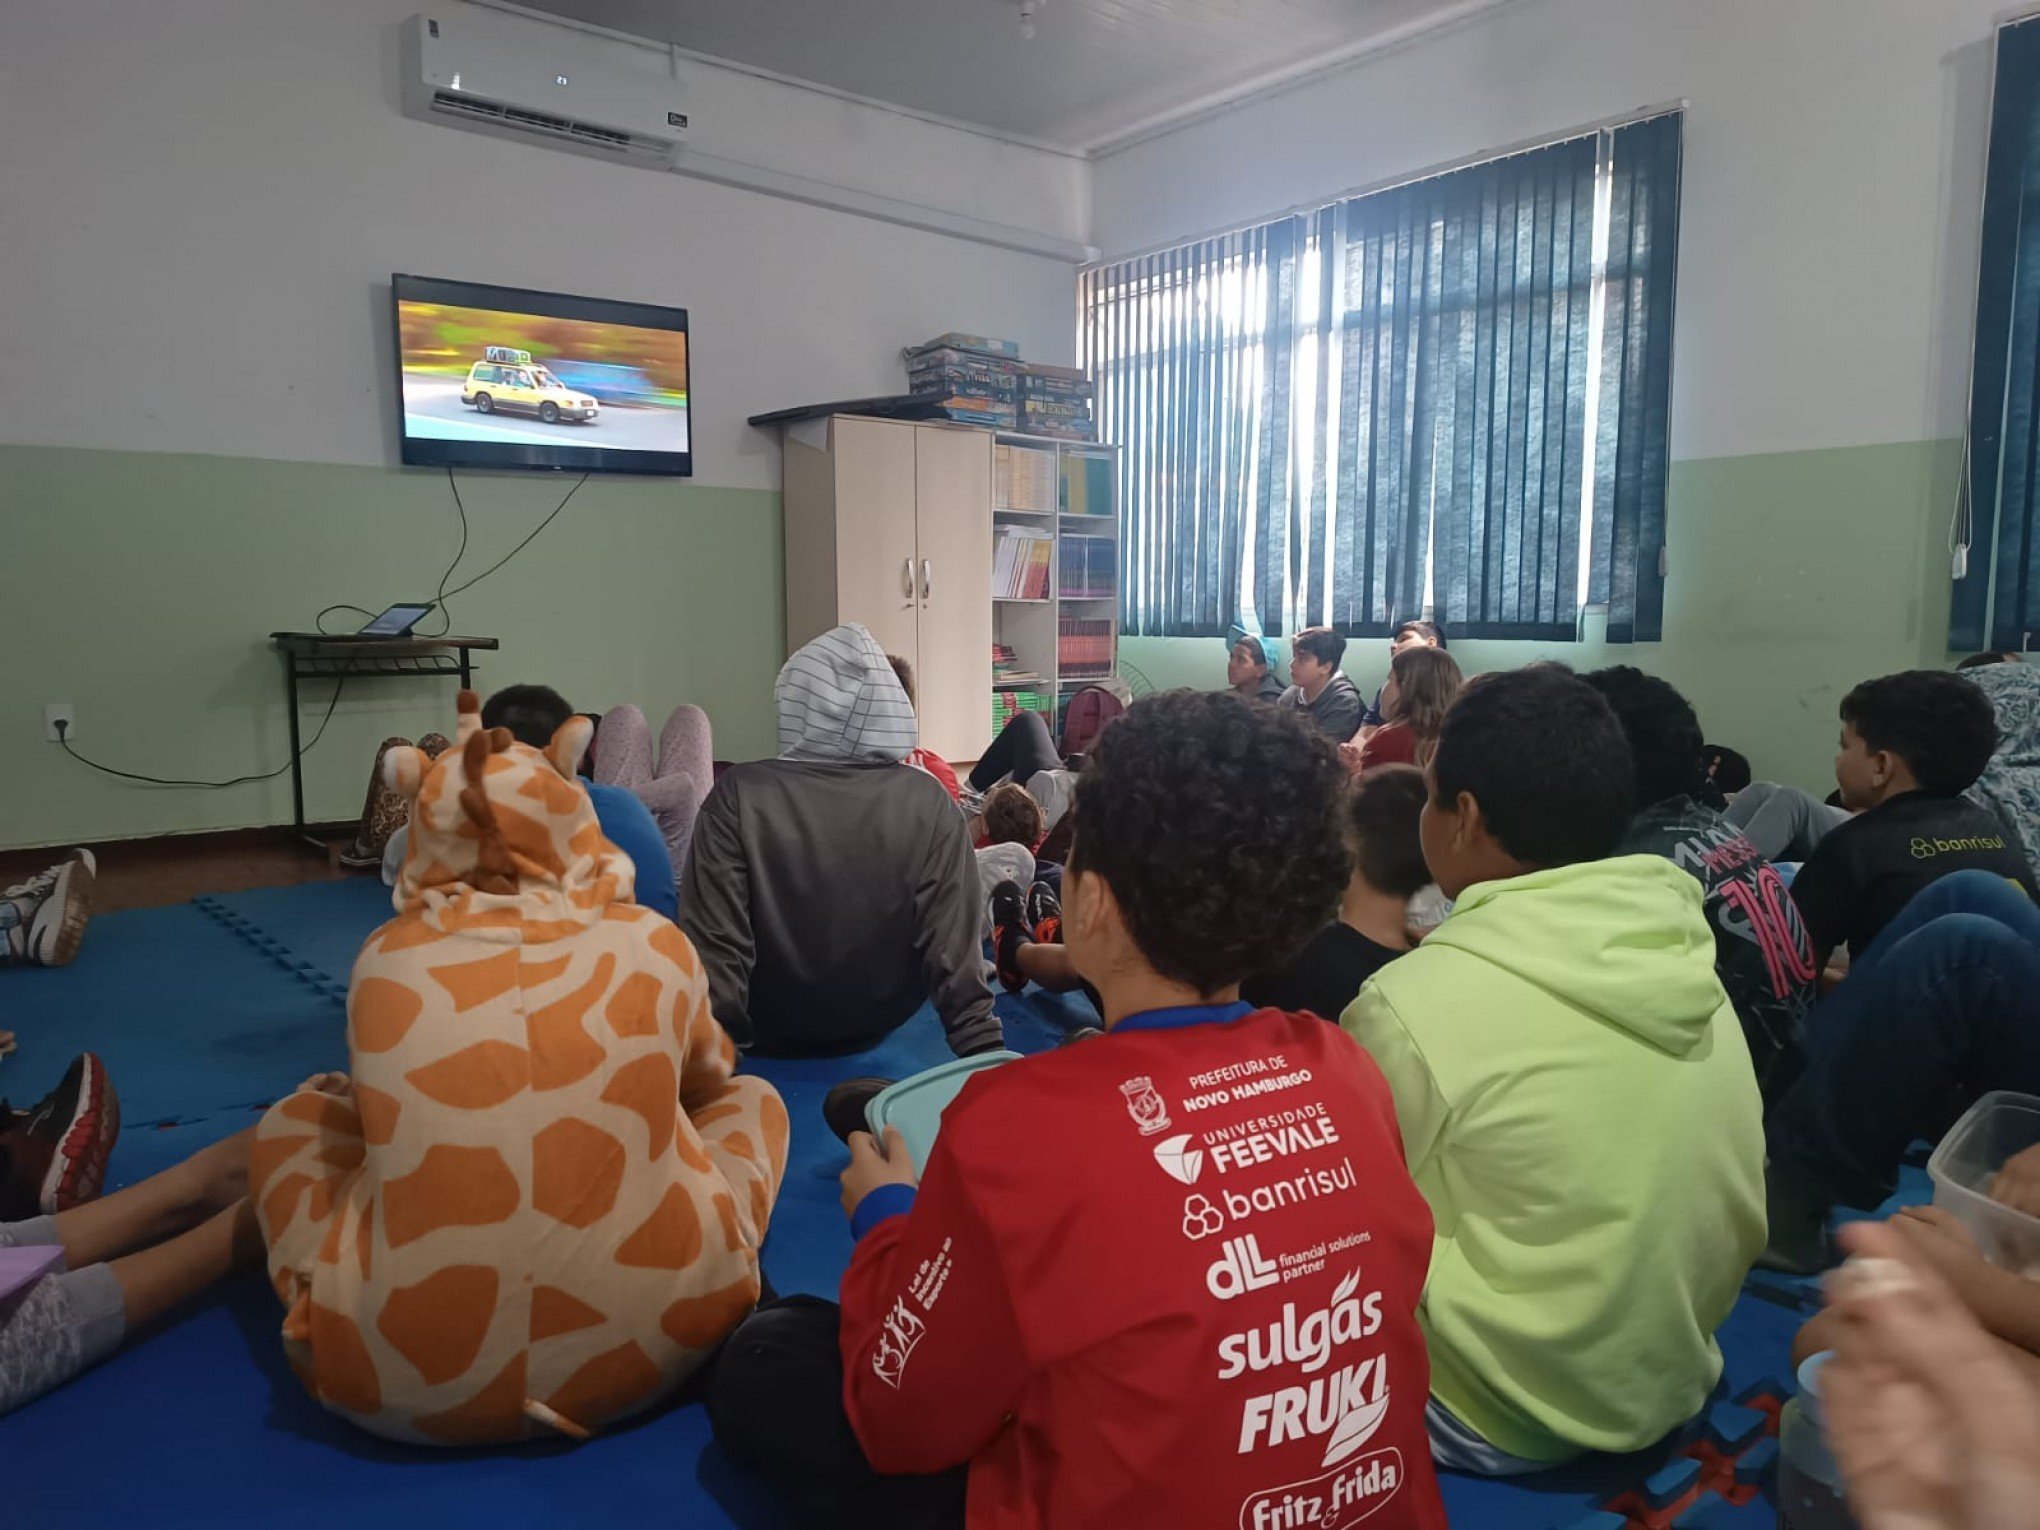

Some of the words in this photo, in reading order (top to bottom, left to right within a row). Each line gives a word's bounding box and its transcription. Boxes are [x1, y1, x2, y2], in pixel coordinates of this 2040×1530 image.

[1932, 834, 2007, 852] banrisul
[1719, 863, 1817, 999] 10
[1182, 1090, 1230, 1113] NOVO
[1230, 1069, 1313, 1100] HAMBURGO
[1188, 1059, 1268, 1090] PREFEITURA
[1267, 1054, 1289, 1071] DE
[1202, 1102, 1327, 1146] UNIVERSIDADE
[1209, 1116, 1340, 1174] FEEVALE
[1222, 1156, 1357, 1221] banrisul
[1278, 1241, 1327, 1268] financial
[1327, 1230, 1371, 1253] solutions
[1282, 1258, 1325, 1284] partner
[1237, 1353, 1388, 1454] FRUKI
[1252, 1494, 1323, 1530] Fritz
